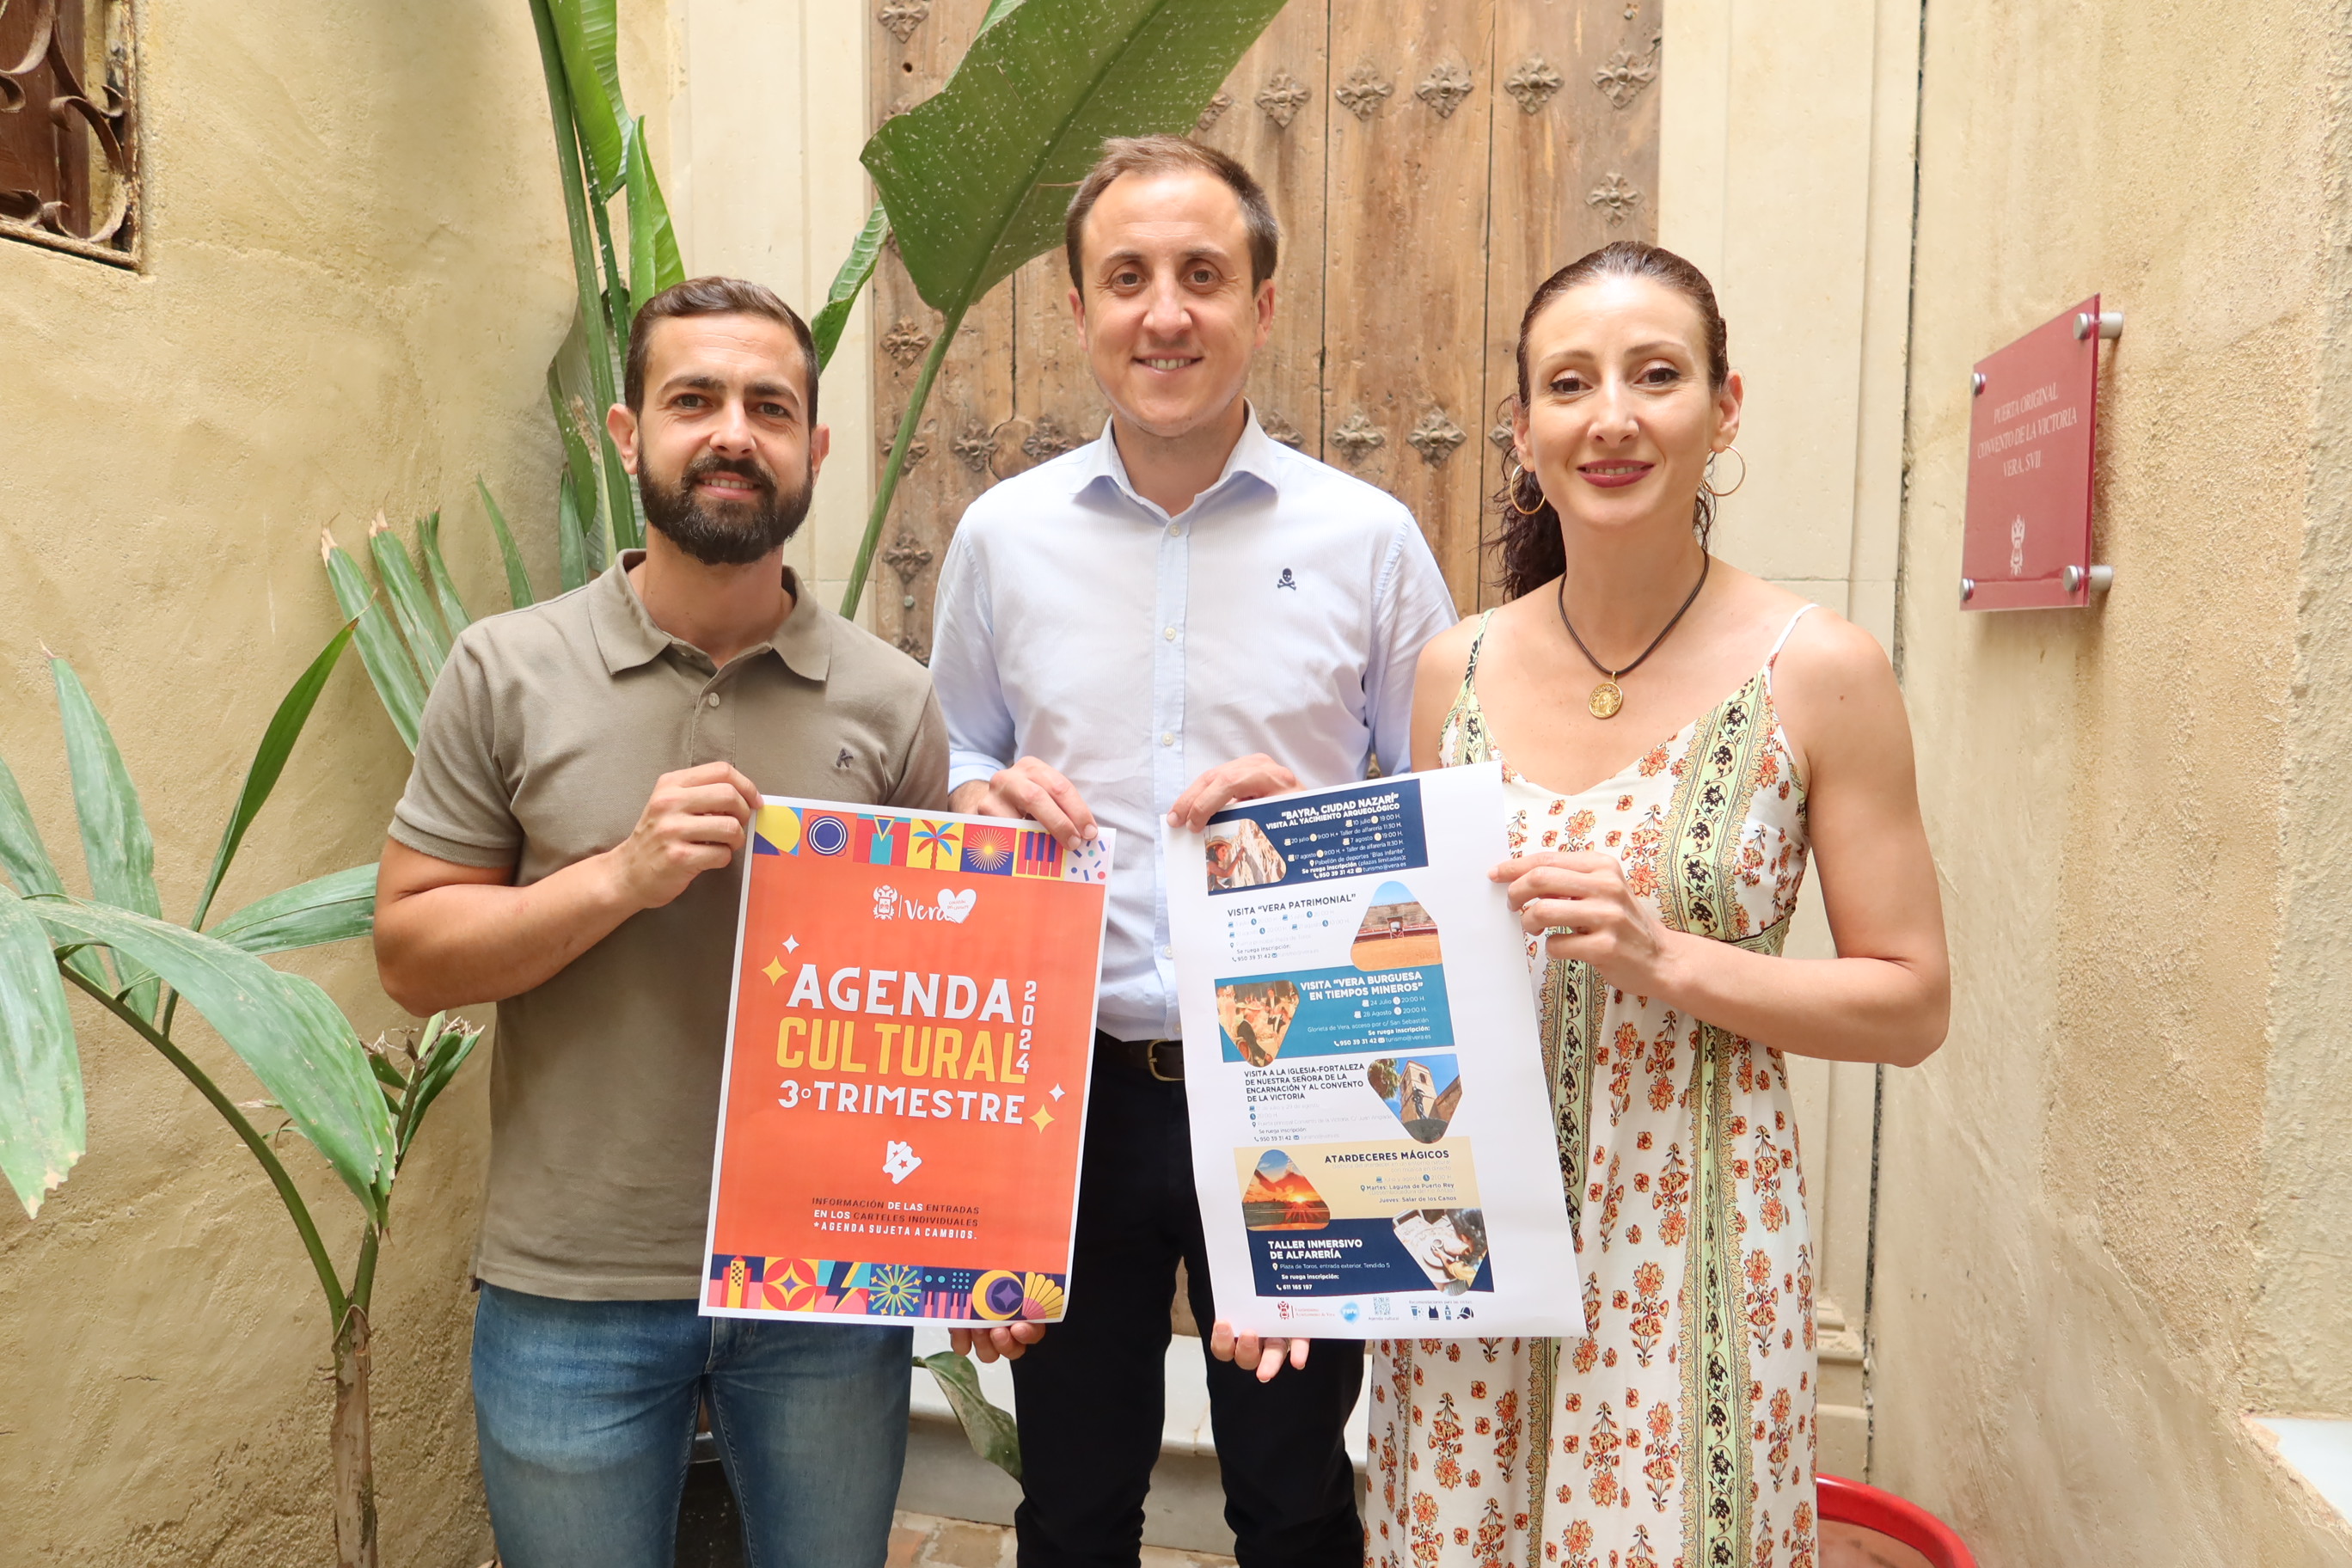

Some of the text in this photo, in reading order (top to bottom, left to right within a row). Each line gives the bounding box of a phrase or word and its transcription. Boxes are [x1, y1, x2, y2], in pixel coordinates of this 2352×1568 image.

[1994, 383, 2058, 425] PUERTA ORIGINAL
[1977, 407, 2077, 459] CONVENTO DE LA VICTORIA
[1320, 801, 1356, 813] CIUDAD
[1265, 820, 1288, 830] VISITA
[1299, 812, 1341, 824] YACIMIENTO
[1344, 803, 1400, 818] ARQUEOLÓGICO
[1228, 907, 1255, 916] VISITA
[1300, 980, 1332, 990] VISITA
[1367, 971, 1423, 984] BURGUESA
[786, 964, 1014, 1023] AGENDA
[1309, 992, 1323, 1001] EN
[1326, 987, 1369, 999] TIEMPOS
[1372, 1008, 1392, 1017] Agosto
[1015, 980, 1037, 1074] 2024
[776, 1016, 1026, 1084] CULTURAL
[1288, 1063, 1364, 1075] IGLESIA-FORTALEZA
[1292, 1075, 1323, 1083] SEÑORA
[1246, 1084, 1300, 1093] ENCARNACIÓN
[1320, 1081, 1364, 1089] CONVENTO
[1325, 1149, 1449, 1163] ATARDECERES MÁGICOS
[812, 1197, 884, 1209] INFORMACIÓN
[903, 1203, 923, 1211] LAS
[926, 1204, 979, 1215] ENTRADAS
[830, 1210, 850, 1219] LOS
[854, 1213, 904, 1222] CARTELES
[909, 1216, 978, 1227] INDIVIDUALES
[869, 1224, 910, 1236] SUJETA
[915, 1228, 921, 1236] A
[925, 1228, 977, 1240] CAMBIOS.
[1268, 1240, 1363, 1249] TALLER INMERSIVO
[1270, 1248, 1341, 1259] DE ALFARERÍA
